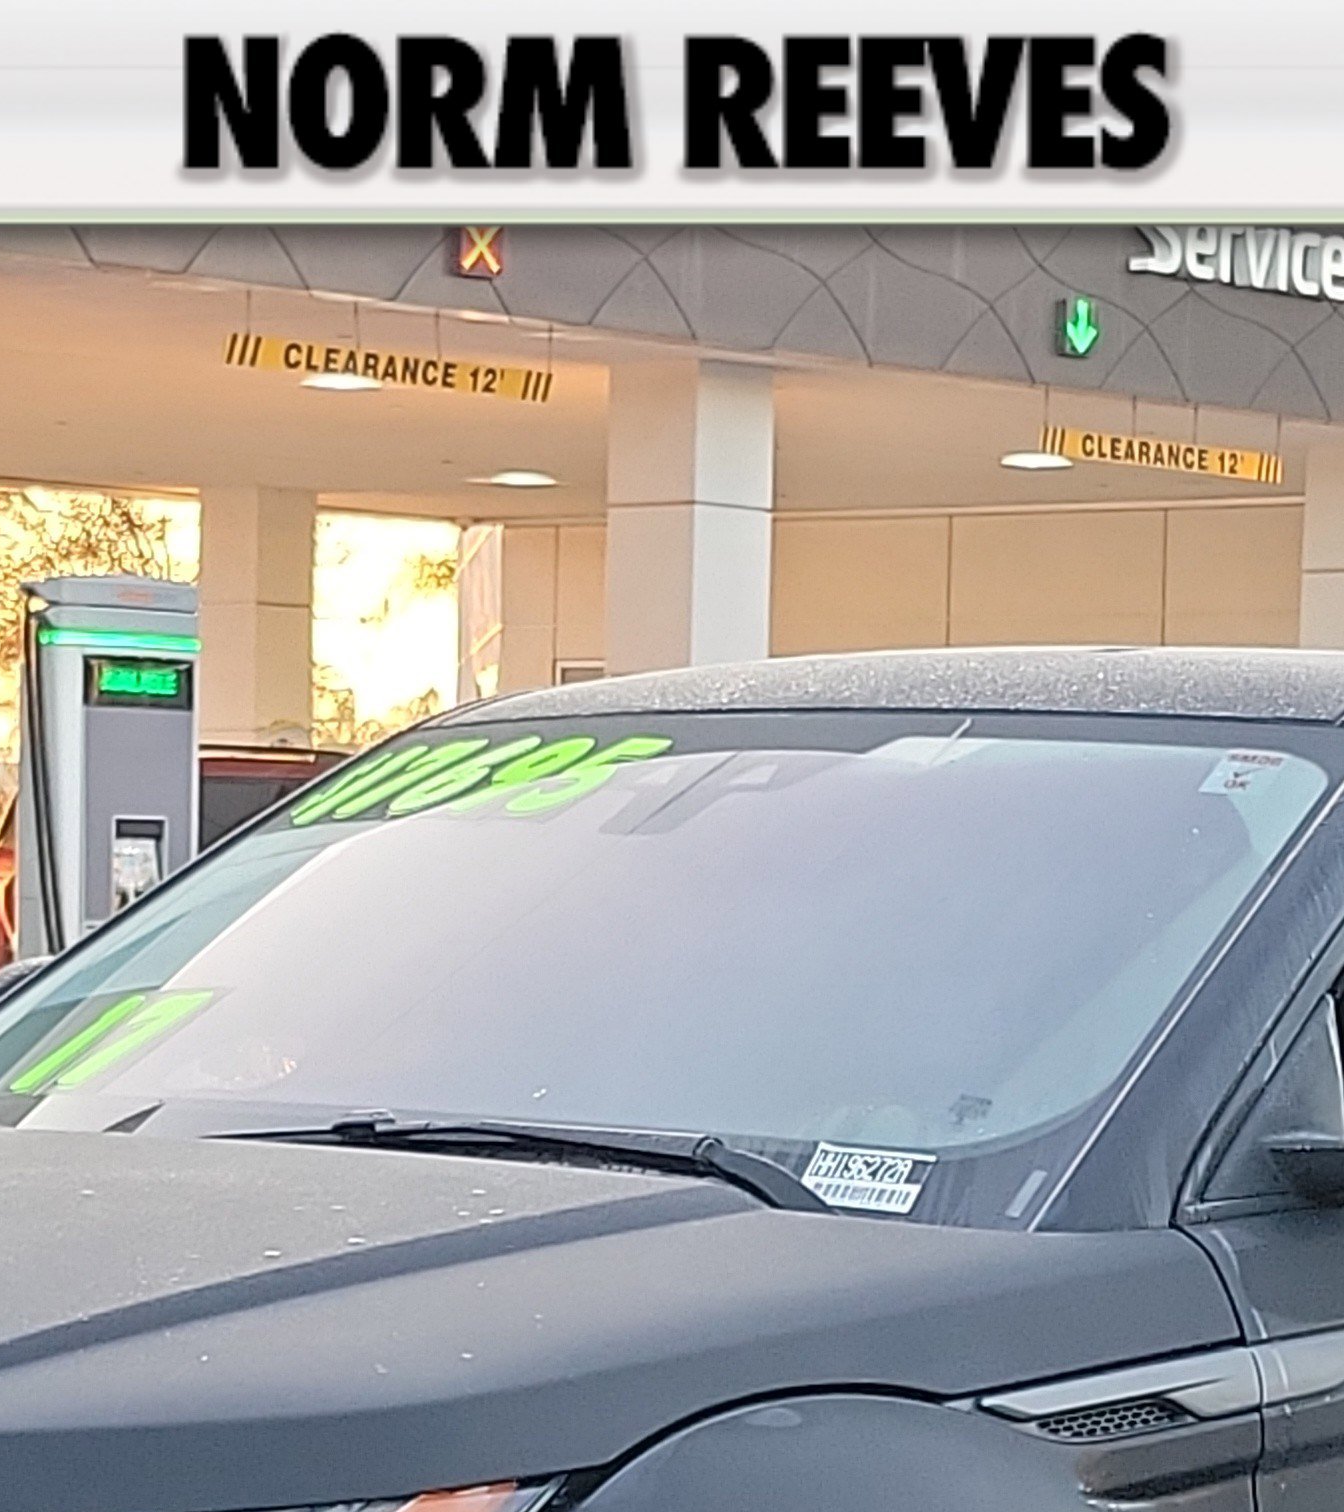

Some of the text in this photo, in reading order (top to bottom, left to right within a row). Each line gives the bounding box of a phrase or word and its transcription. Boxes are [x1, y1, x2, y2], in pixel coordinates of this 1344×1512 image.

[283, 343, 505, 393] CLEARANCE 12'
[1081, 433, 1245, 475] CLEARANCE 12'
[10, 990, 213, 1095] 17
